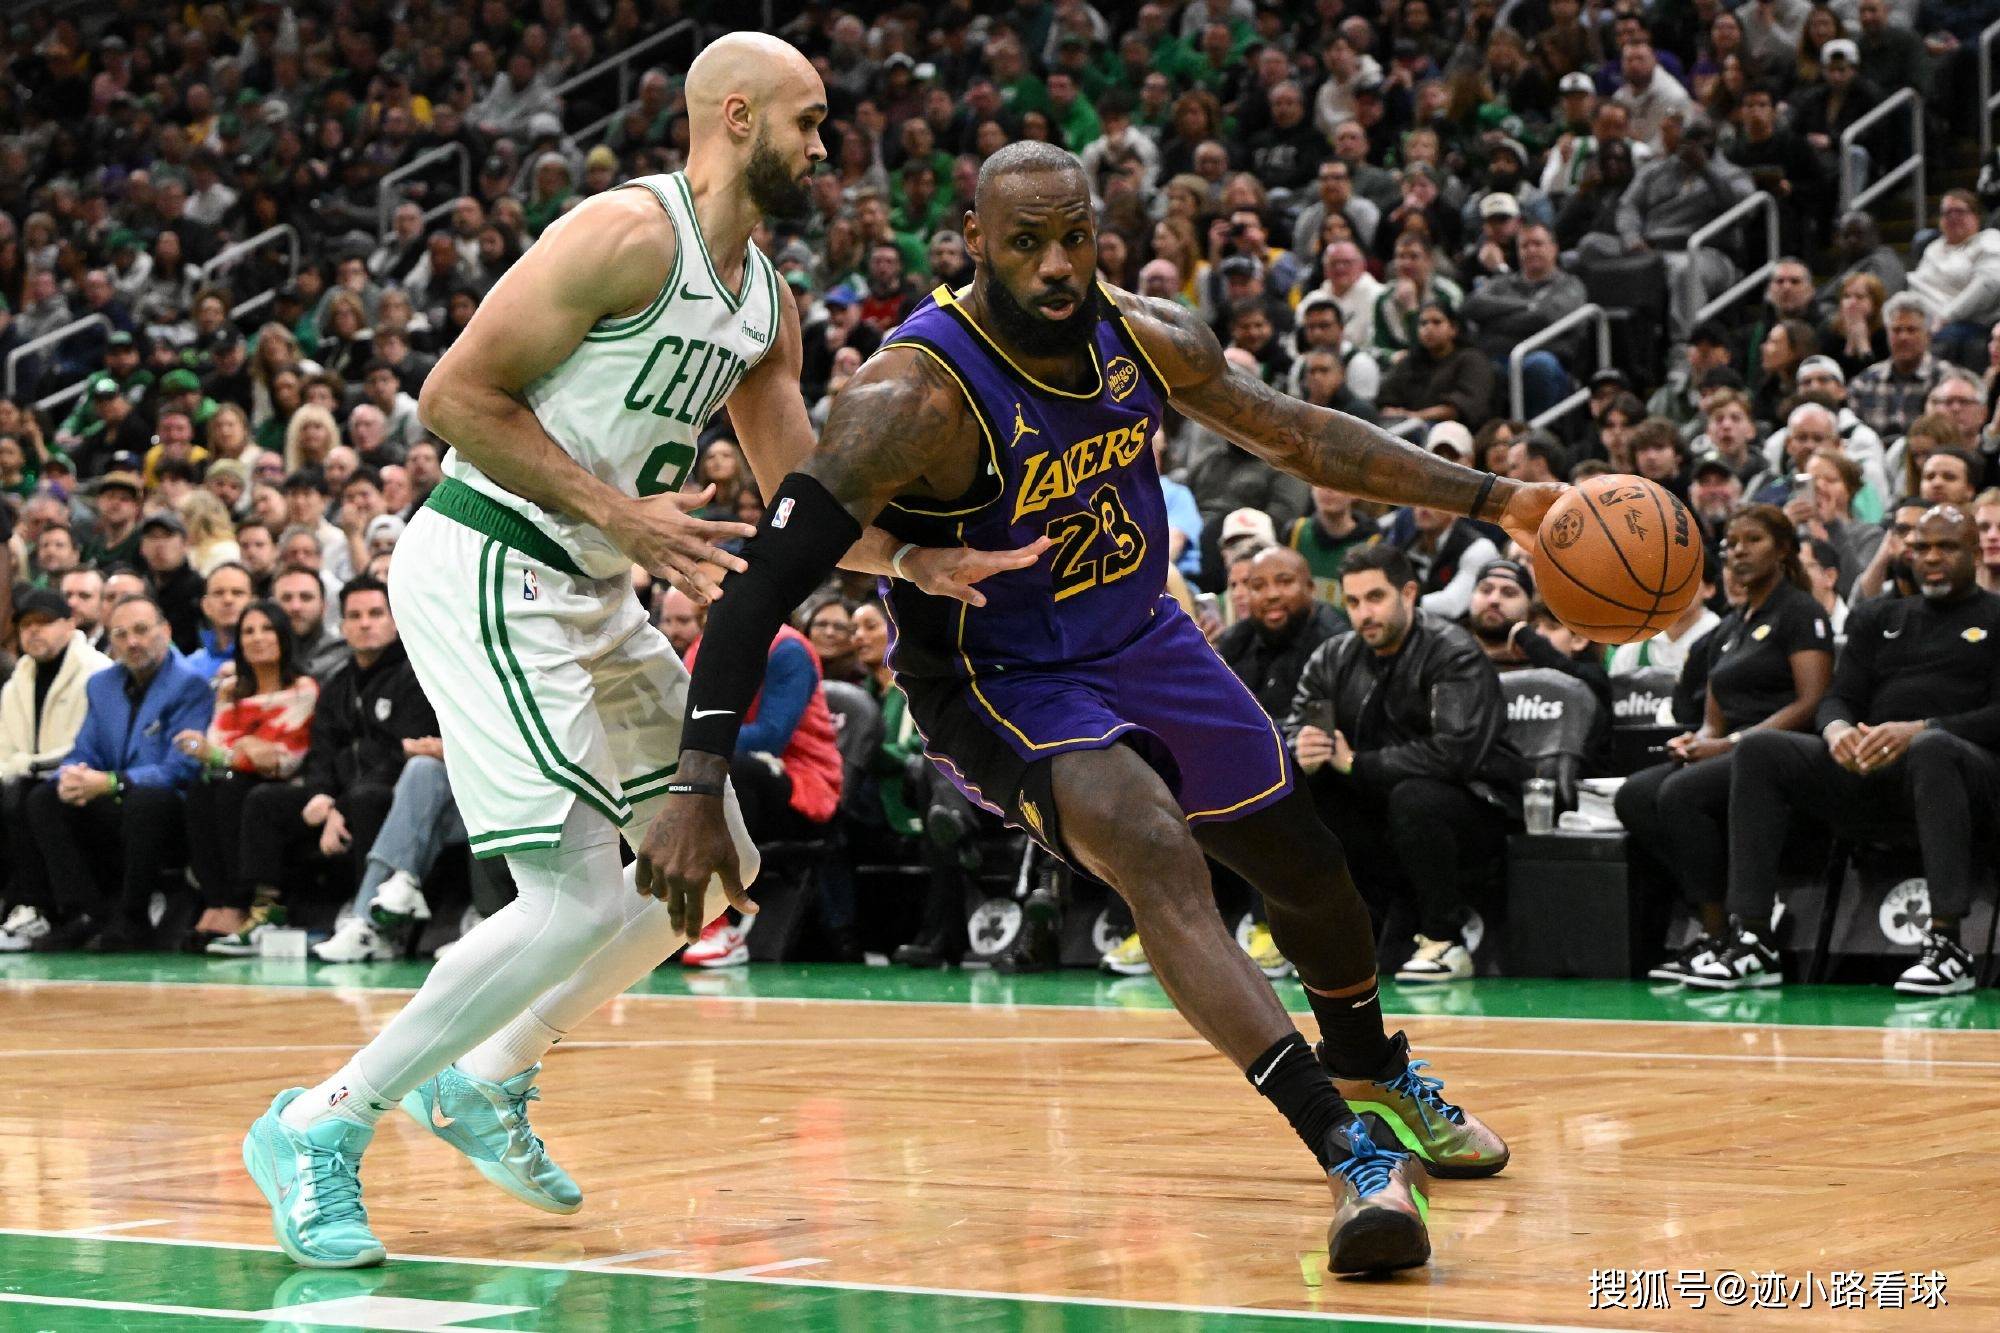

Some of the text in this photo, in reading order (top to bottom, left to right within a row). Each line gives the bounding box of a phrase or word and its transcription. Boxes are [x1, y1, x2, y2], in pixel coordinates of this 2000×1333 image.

[742, 320, 766, 343] Amica
[624, 336, 747, 427] CELTIC
[1011, 417, 1149, 526] LAKERS
[1046, 483, 1147, 602] 23
[1508, 694, 1564, 720] eltics
